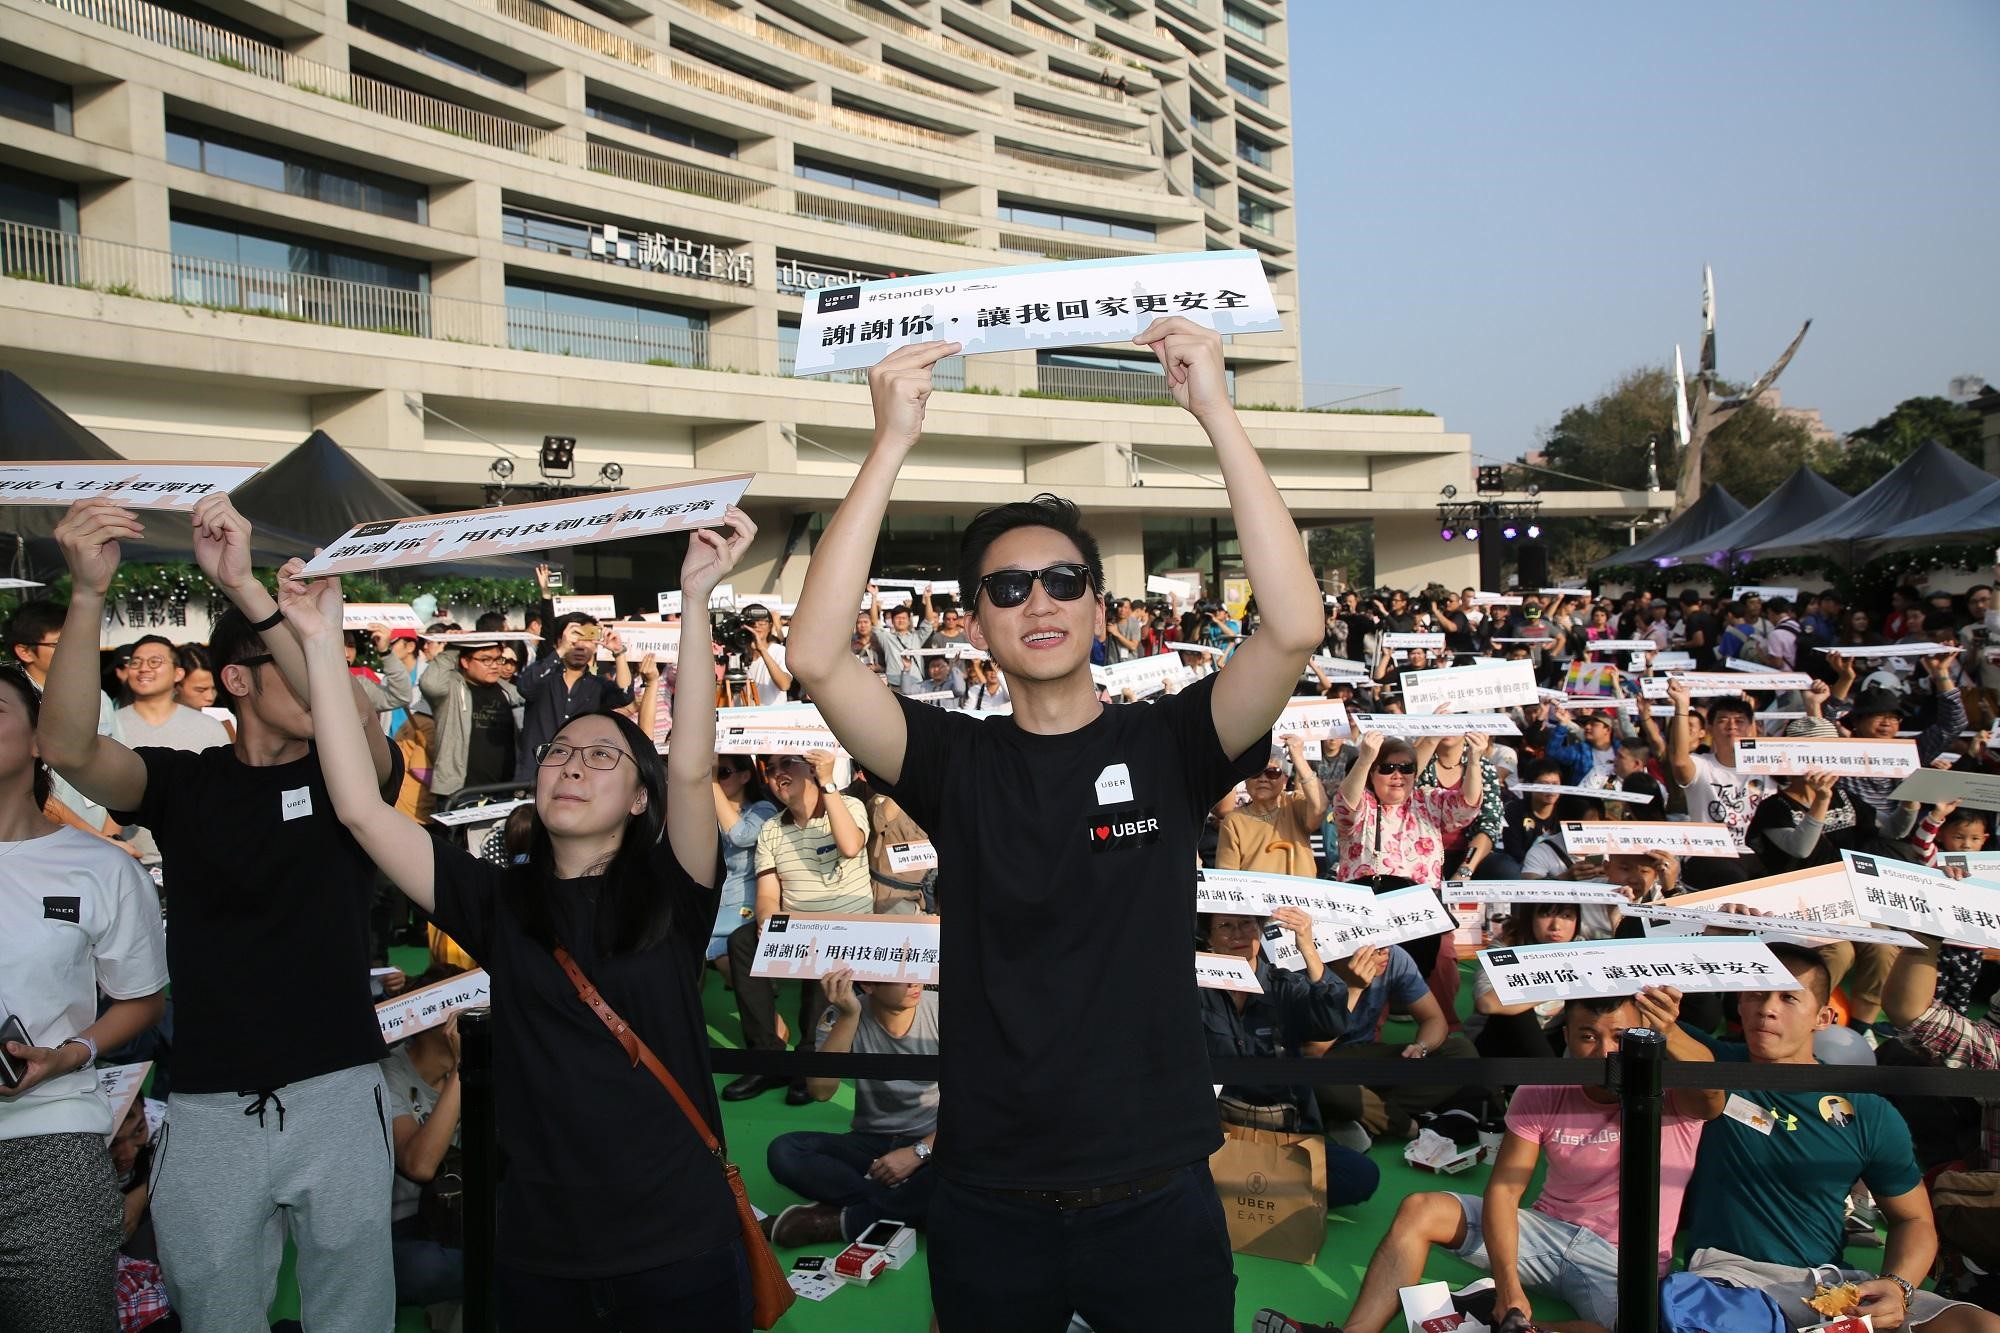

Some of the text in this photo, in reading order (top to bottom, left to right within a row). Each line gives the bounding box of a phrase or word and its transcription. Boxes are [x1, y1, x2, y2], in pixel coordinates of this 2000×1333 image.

[638, 231, 753, 285] 誠品生活
[782, 260, 820, 290] the
[824, 294, 854, 303] UBER
[868, 284, 957, 303] #StandByU
[822, 289, 1250, 347] 謝謝你，讓我回家更安全
[328, 499, 717, 560] 謝謝你，用科技創造新經濟
[1101, 779, 1126, 789] UBER
[286, 799, 307, 809] UBER
[1090, 818, 1159, 841] I UBER
[1865, 886, 2000, 929] 謝謝你，讓我
[790, 922, 830, 932] #StandByU
[763, 943, 940, 963] 謝謝你，用科技創造新經
[1522, 950, 1579, 961] #StandByU
[1505, 961, 1773, 988] 謝謝你，讓我回家更安全
[381, 987, 488, 1032] 你，讓我收入
[1237, 1196, 1276, 1211] UBER
[1238, 1210, 1276, 1225] EATS
